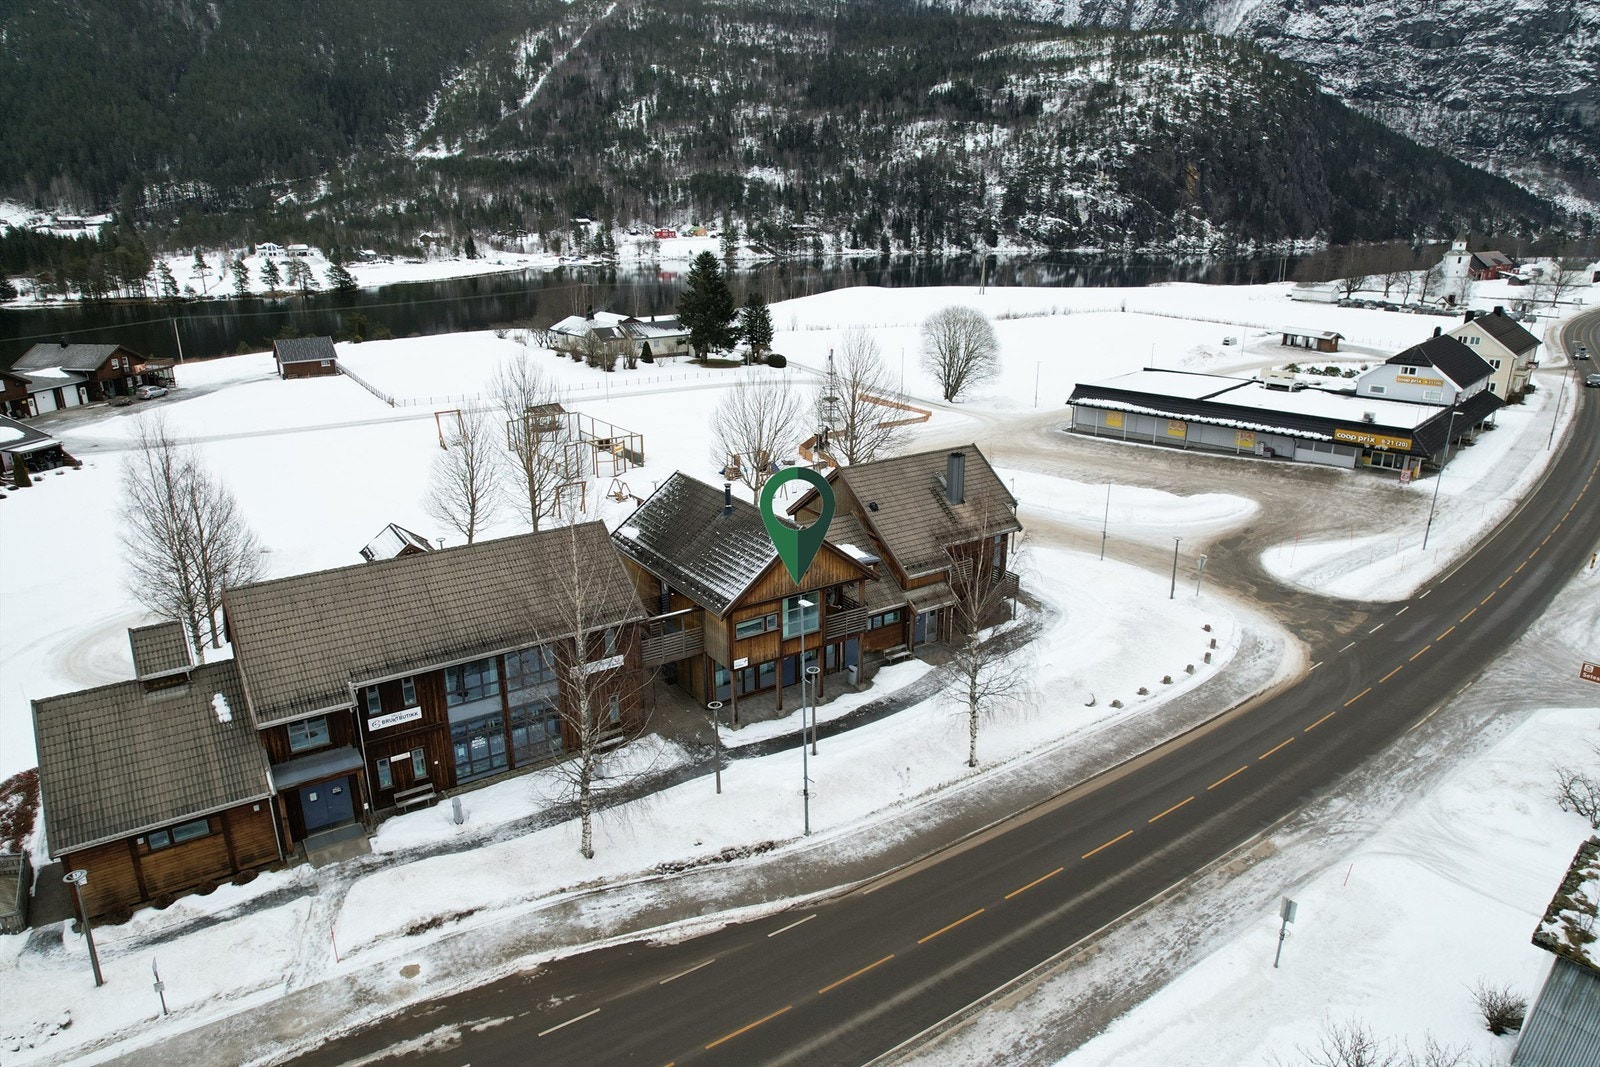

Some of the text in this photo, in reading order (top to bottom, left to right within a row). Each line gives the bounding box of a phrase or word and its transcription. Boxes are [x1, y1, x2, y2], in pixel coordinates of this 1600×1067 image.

[1337, 432, 1356, 440] coop
[1358, 434, 1375, 443] prix
[381, 711, 419, 725] BRUKTBUTIKK
